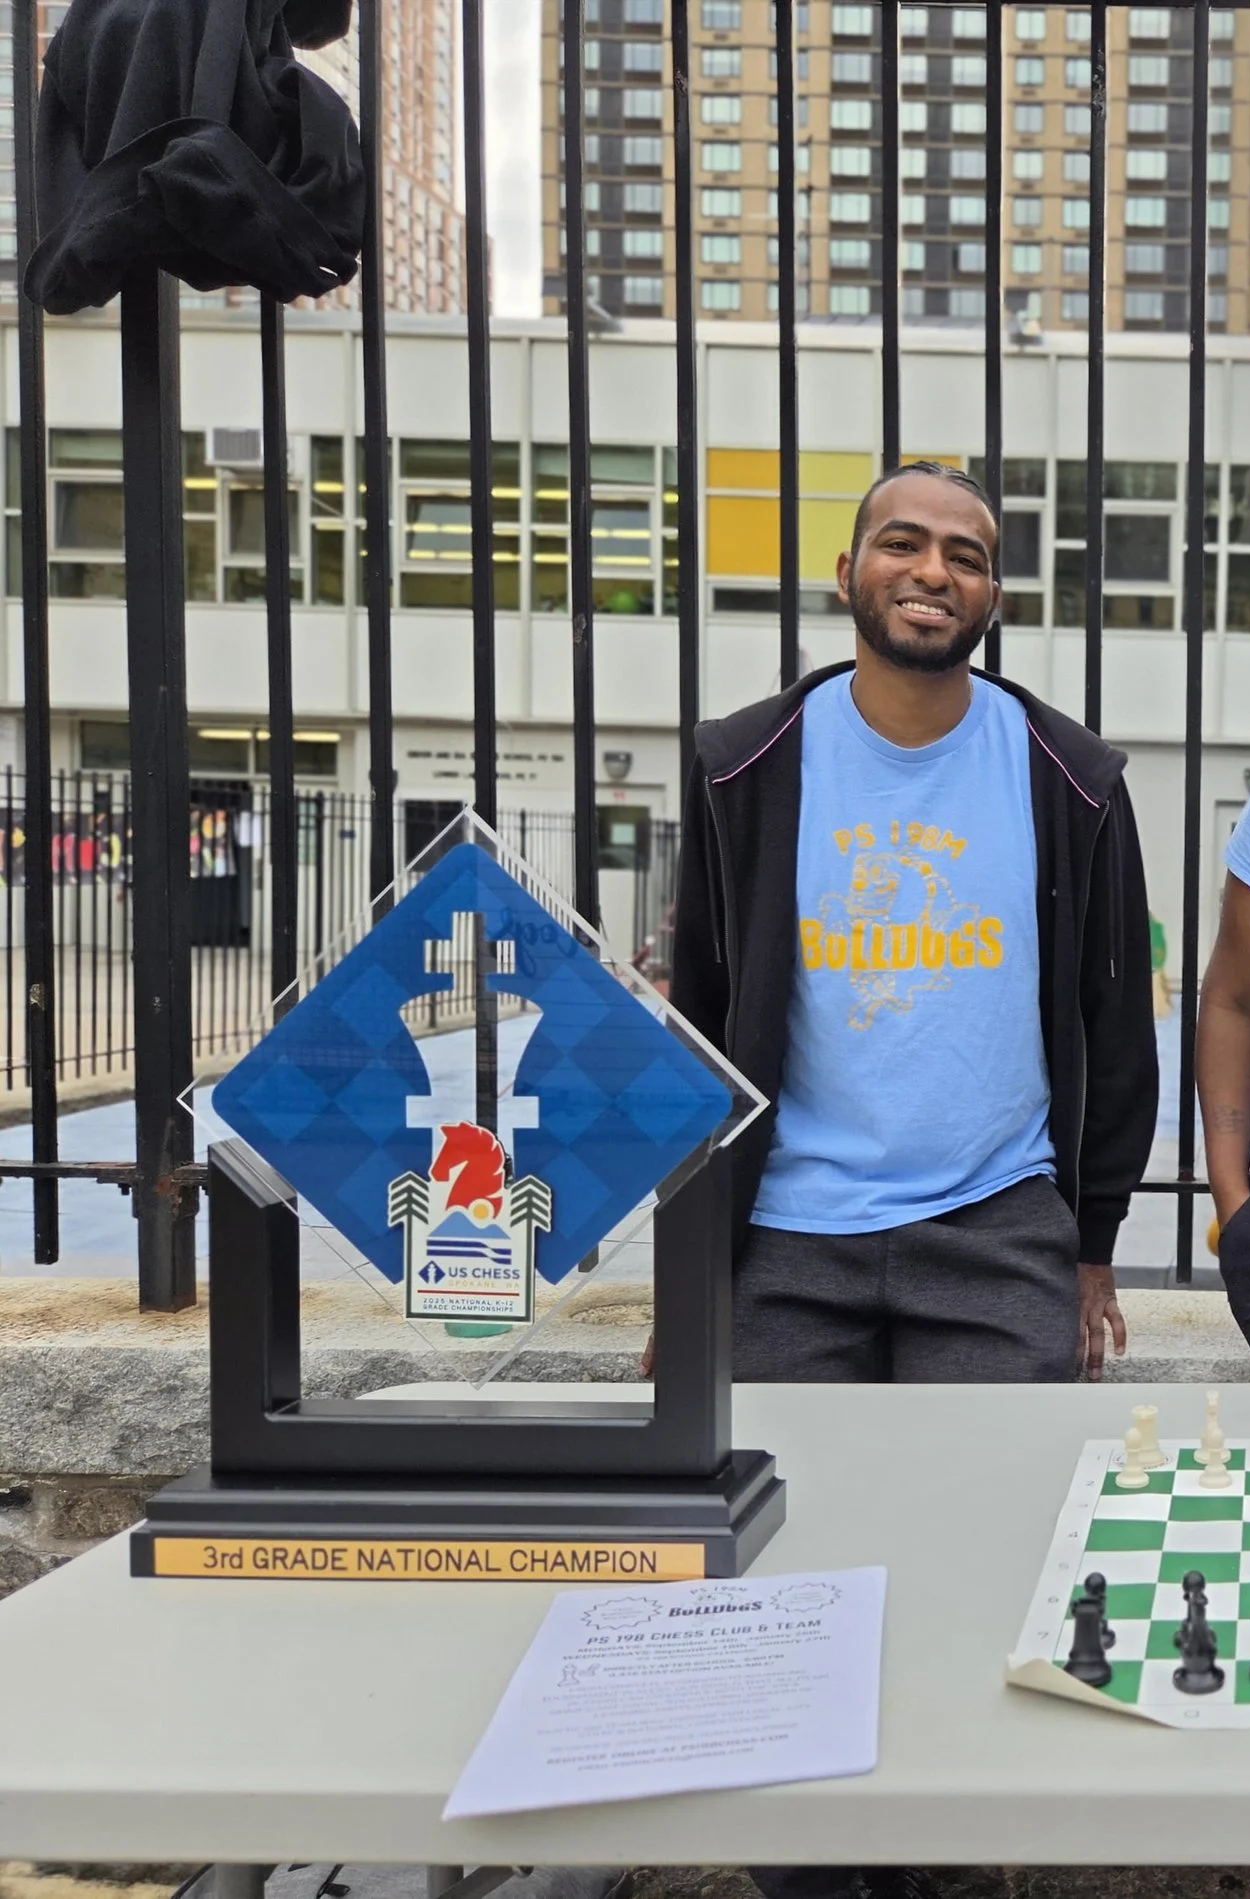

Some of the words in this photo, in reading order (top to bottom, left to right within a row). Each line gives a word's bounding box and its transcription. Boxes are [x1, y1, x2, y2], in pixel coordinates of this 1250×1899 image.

[833, 823, 876, 856] PS
[891, 819, 968, 860] 198M
[448, 1267, 468, 1278] US
[472, 1267, 520, 1280] CHESS
[451, 1304, 514, 1313] CHAMPIONSHIPS
[203, 1546, 244, 1569] 3rd
[252, 1547, 348, 1571] GRADE
[357, 1548, 502, 1572] NATIONAL
[509, 1549, 657, 1573] CHAMPION
[587, 1636, 610, 1645] PS
[616, 1633, 645, 1643] 198
[650, 1629, 705, 1641] CHESS
[710, 1626, 752, 1637] CLUB
[758, 1623, 768, 1633] &
[776, 1619, 822, 1630] TEAM
